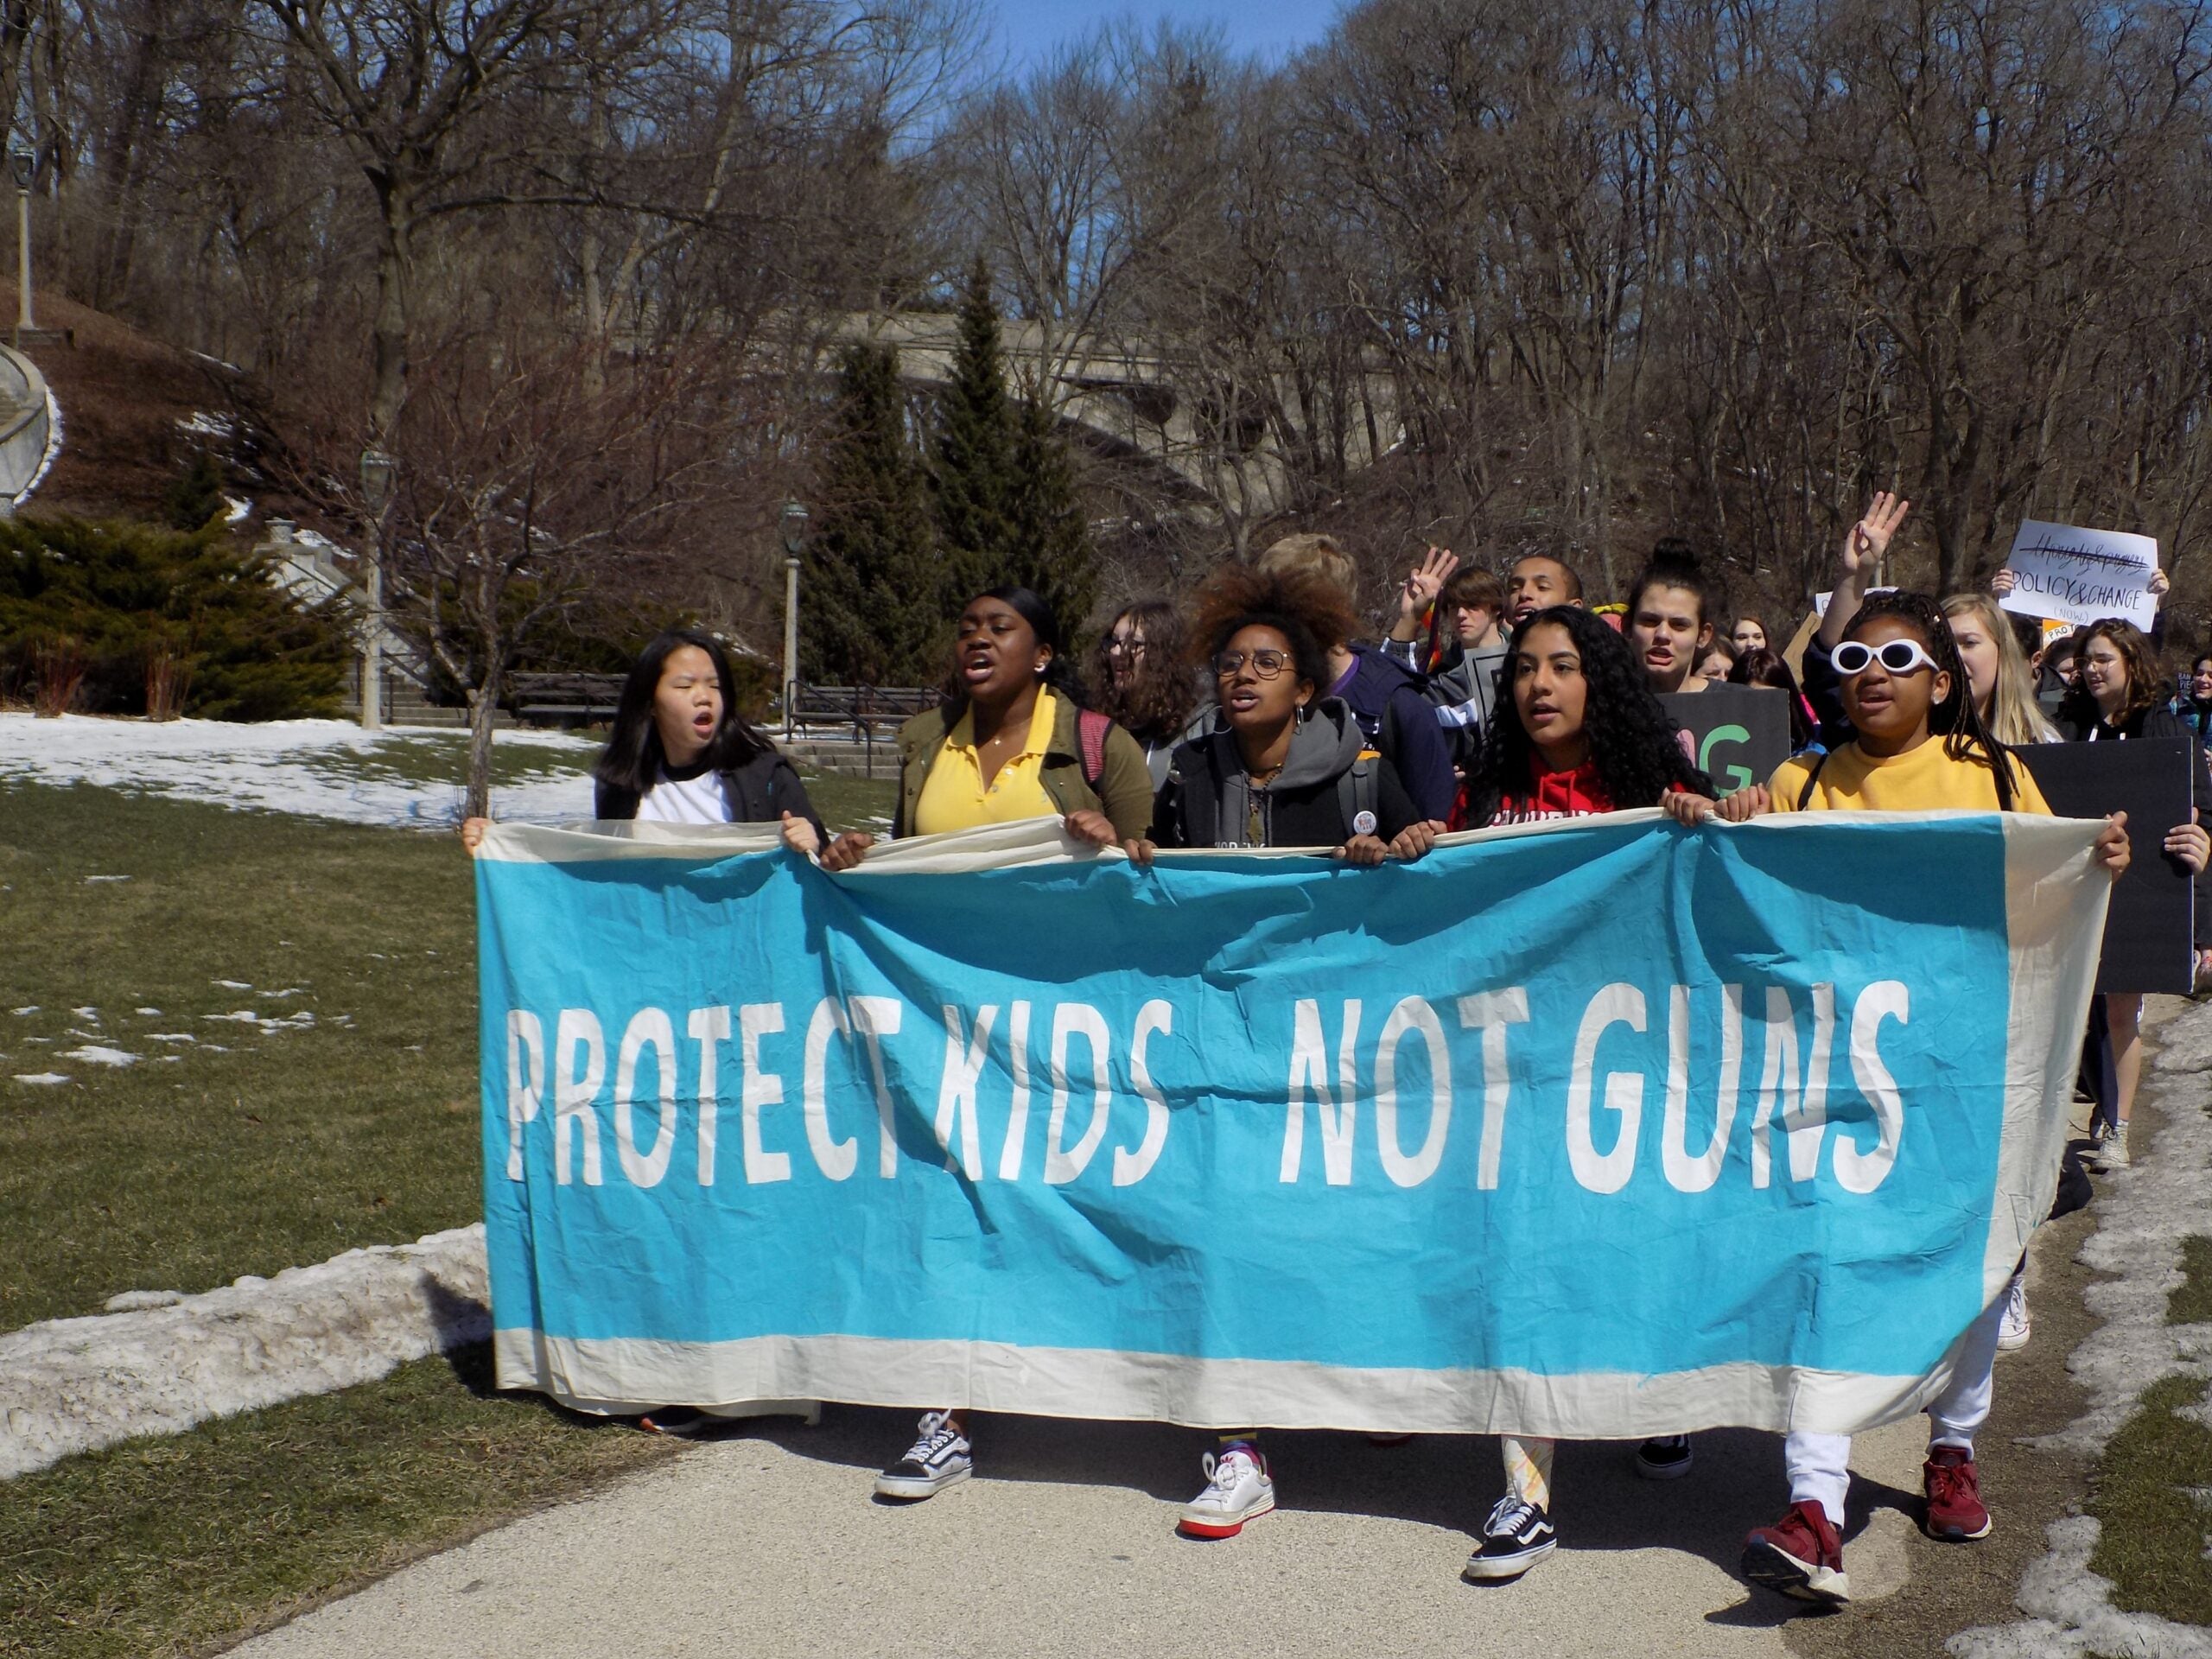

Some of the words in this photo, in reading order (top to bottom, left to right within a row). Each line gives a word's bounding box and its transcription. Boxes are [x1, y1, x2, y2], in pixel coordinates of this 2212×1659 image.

[507, 995, 902, 1188] PROTECT
[934, 998, 1173, 1187] KIDS
[1279, 986, 1530, 1190] NOT
[1565, 980, 1910, 1194] GUNS
